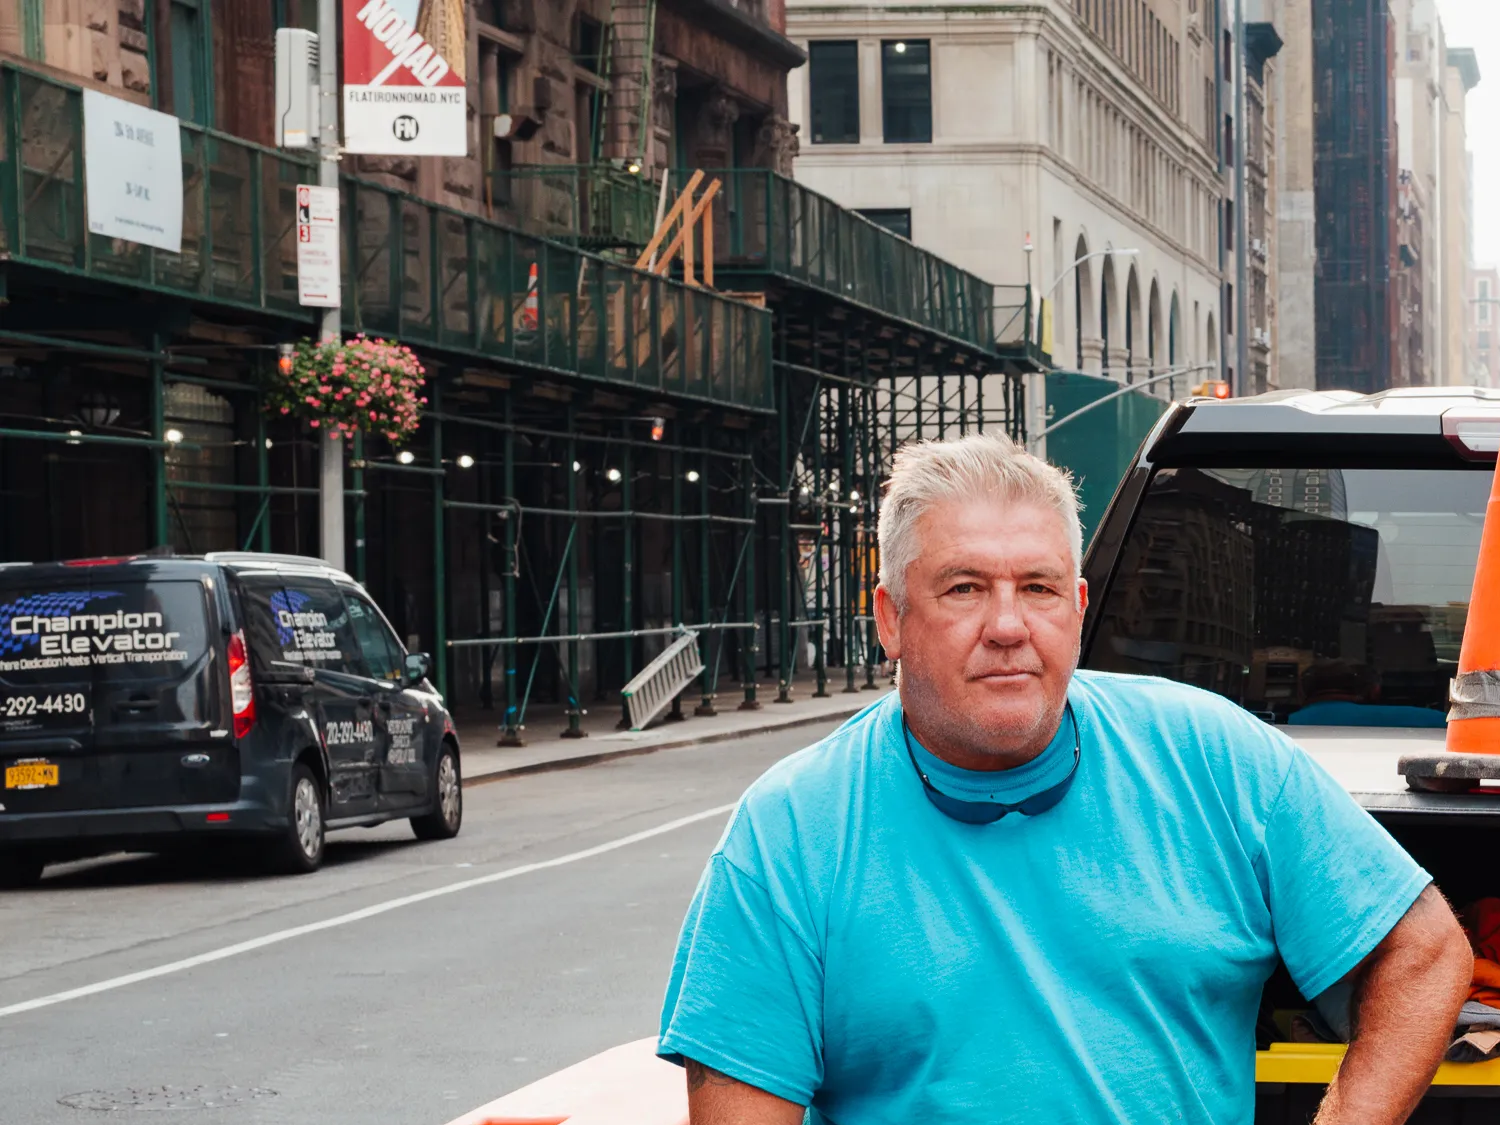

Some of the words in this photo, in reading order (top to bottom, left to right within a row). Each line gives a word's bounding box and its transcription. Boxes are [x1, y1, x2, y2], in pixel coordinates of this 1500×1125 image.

[356, 0, 449, 87] NOMAD
[394, 117, 418, 140] FN
[11, 609, 163, 635] Champion
[41, 630, 180, 656] Elevator
[0, 659, 19, 671] here
[0, 693, 86, 717] -292-4430
